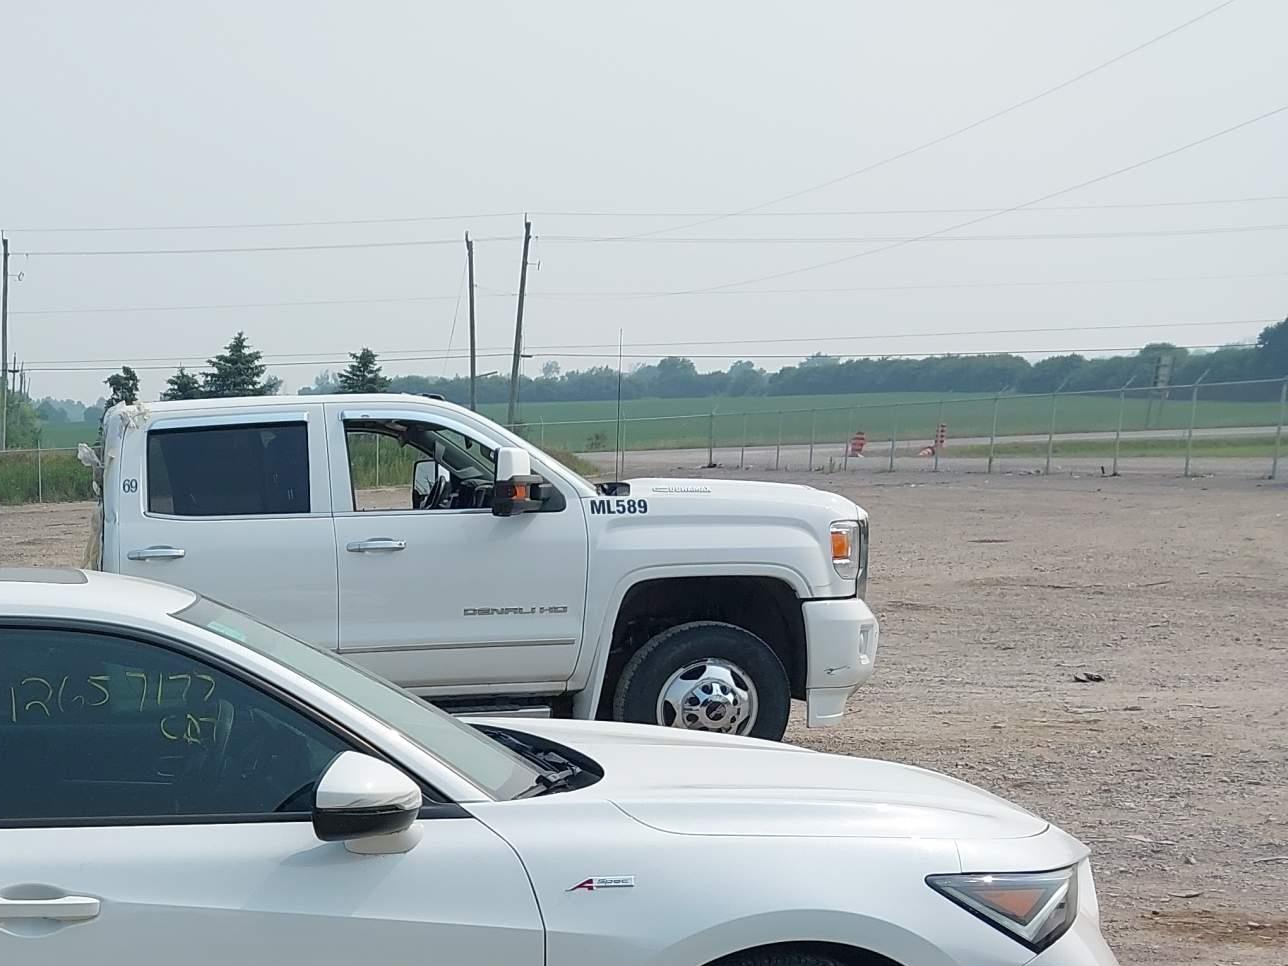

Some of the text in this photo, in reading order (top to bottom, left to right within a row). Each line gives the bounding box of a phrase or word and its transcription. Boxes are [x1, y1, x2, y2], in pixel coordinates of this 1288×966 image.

[123, 479, 138, 493] 69
[590, 499, 648, 515] ML589
[463, 606, 568, 616] DENALI HD
